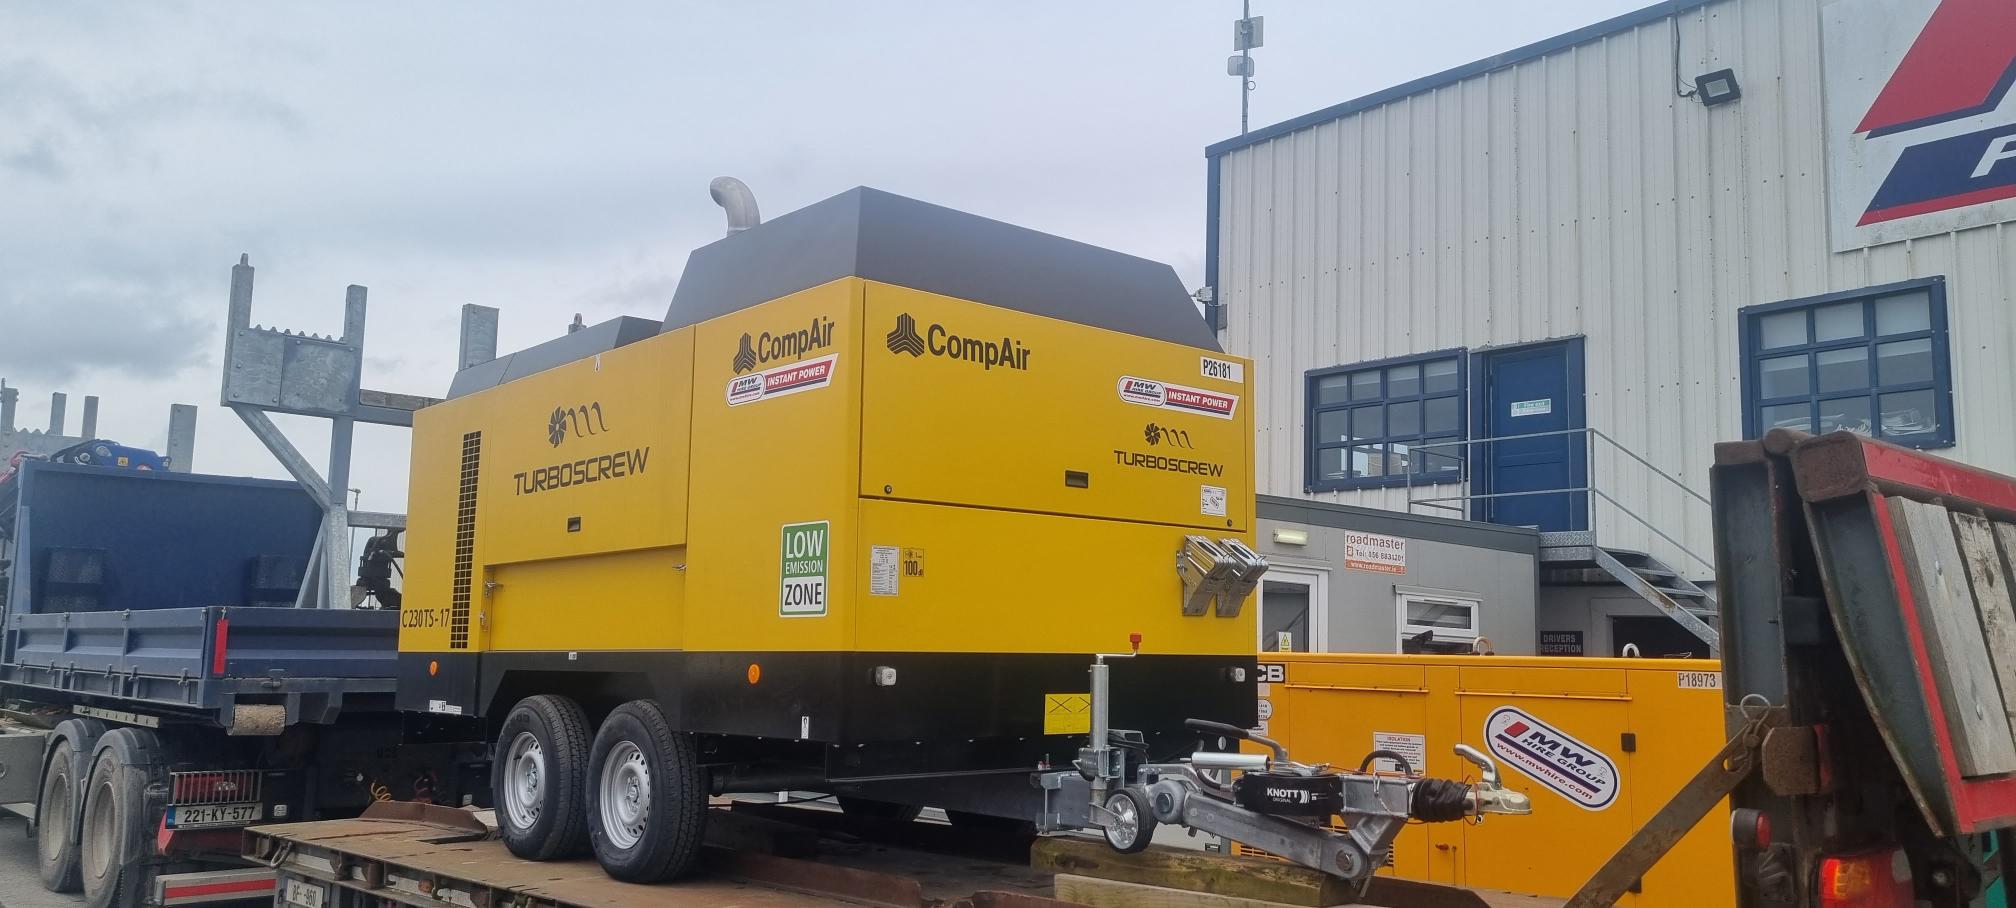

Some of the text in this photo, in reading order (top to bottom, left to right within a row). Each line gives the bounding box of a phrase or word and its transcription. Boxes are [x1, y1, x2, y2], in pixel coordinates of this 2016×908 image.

[758, 315, 835, 363] CompAir
[927, 323, 1031, 371] CompAir
[767, 365, 826, 387] INSTANT POWER
[1203, 358, 1231, 380] P26181
[738, 376, 758, 388] MW
[1133, 381, 1157, 391] MW
[1168, 390, 1228, 409] INSTANT POWER
[513, 446, 650, 496] TURBOSCREW
[1113, 449, 1224, 478] TURBOSCREW
[785, 529, 824, 559] LOW
[1346, 534, 1405, 550] roadmaster
[785, 559, 823, 575] EMISSION
[903, 560, 918, 576] 100
[784, 582, 823, 606] ZONE
[1543, 634, 1576, 643] DRIVERS
[1257, 664, 1284, 682] CB
[1678, 673, 1716, 688] P18973
[1528, 731, 1596, 768] MW
[1496, 742, 1593, 800] www.mwhire.com
[1521, 738, 1606, 786] HIRE GROUP
[1266, 787, 1299, 798] KNOTT
[184, 806, 255, 823] 221-KY-577
